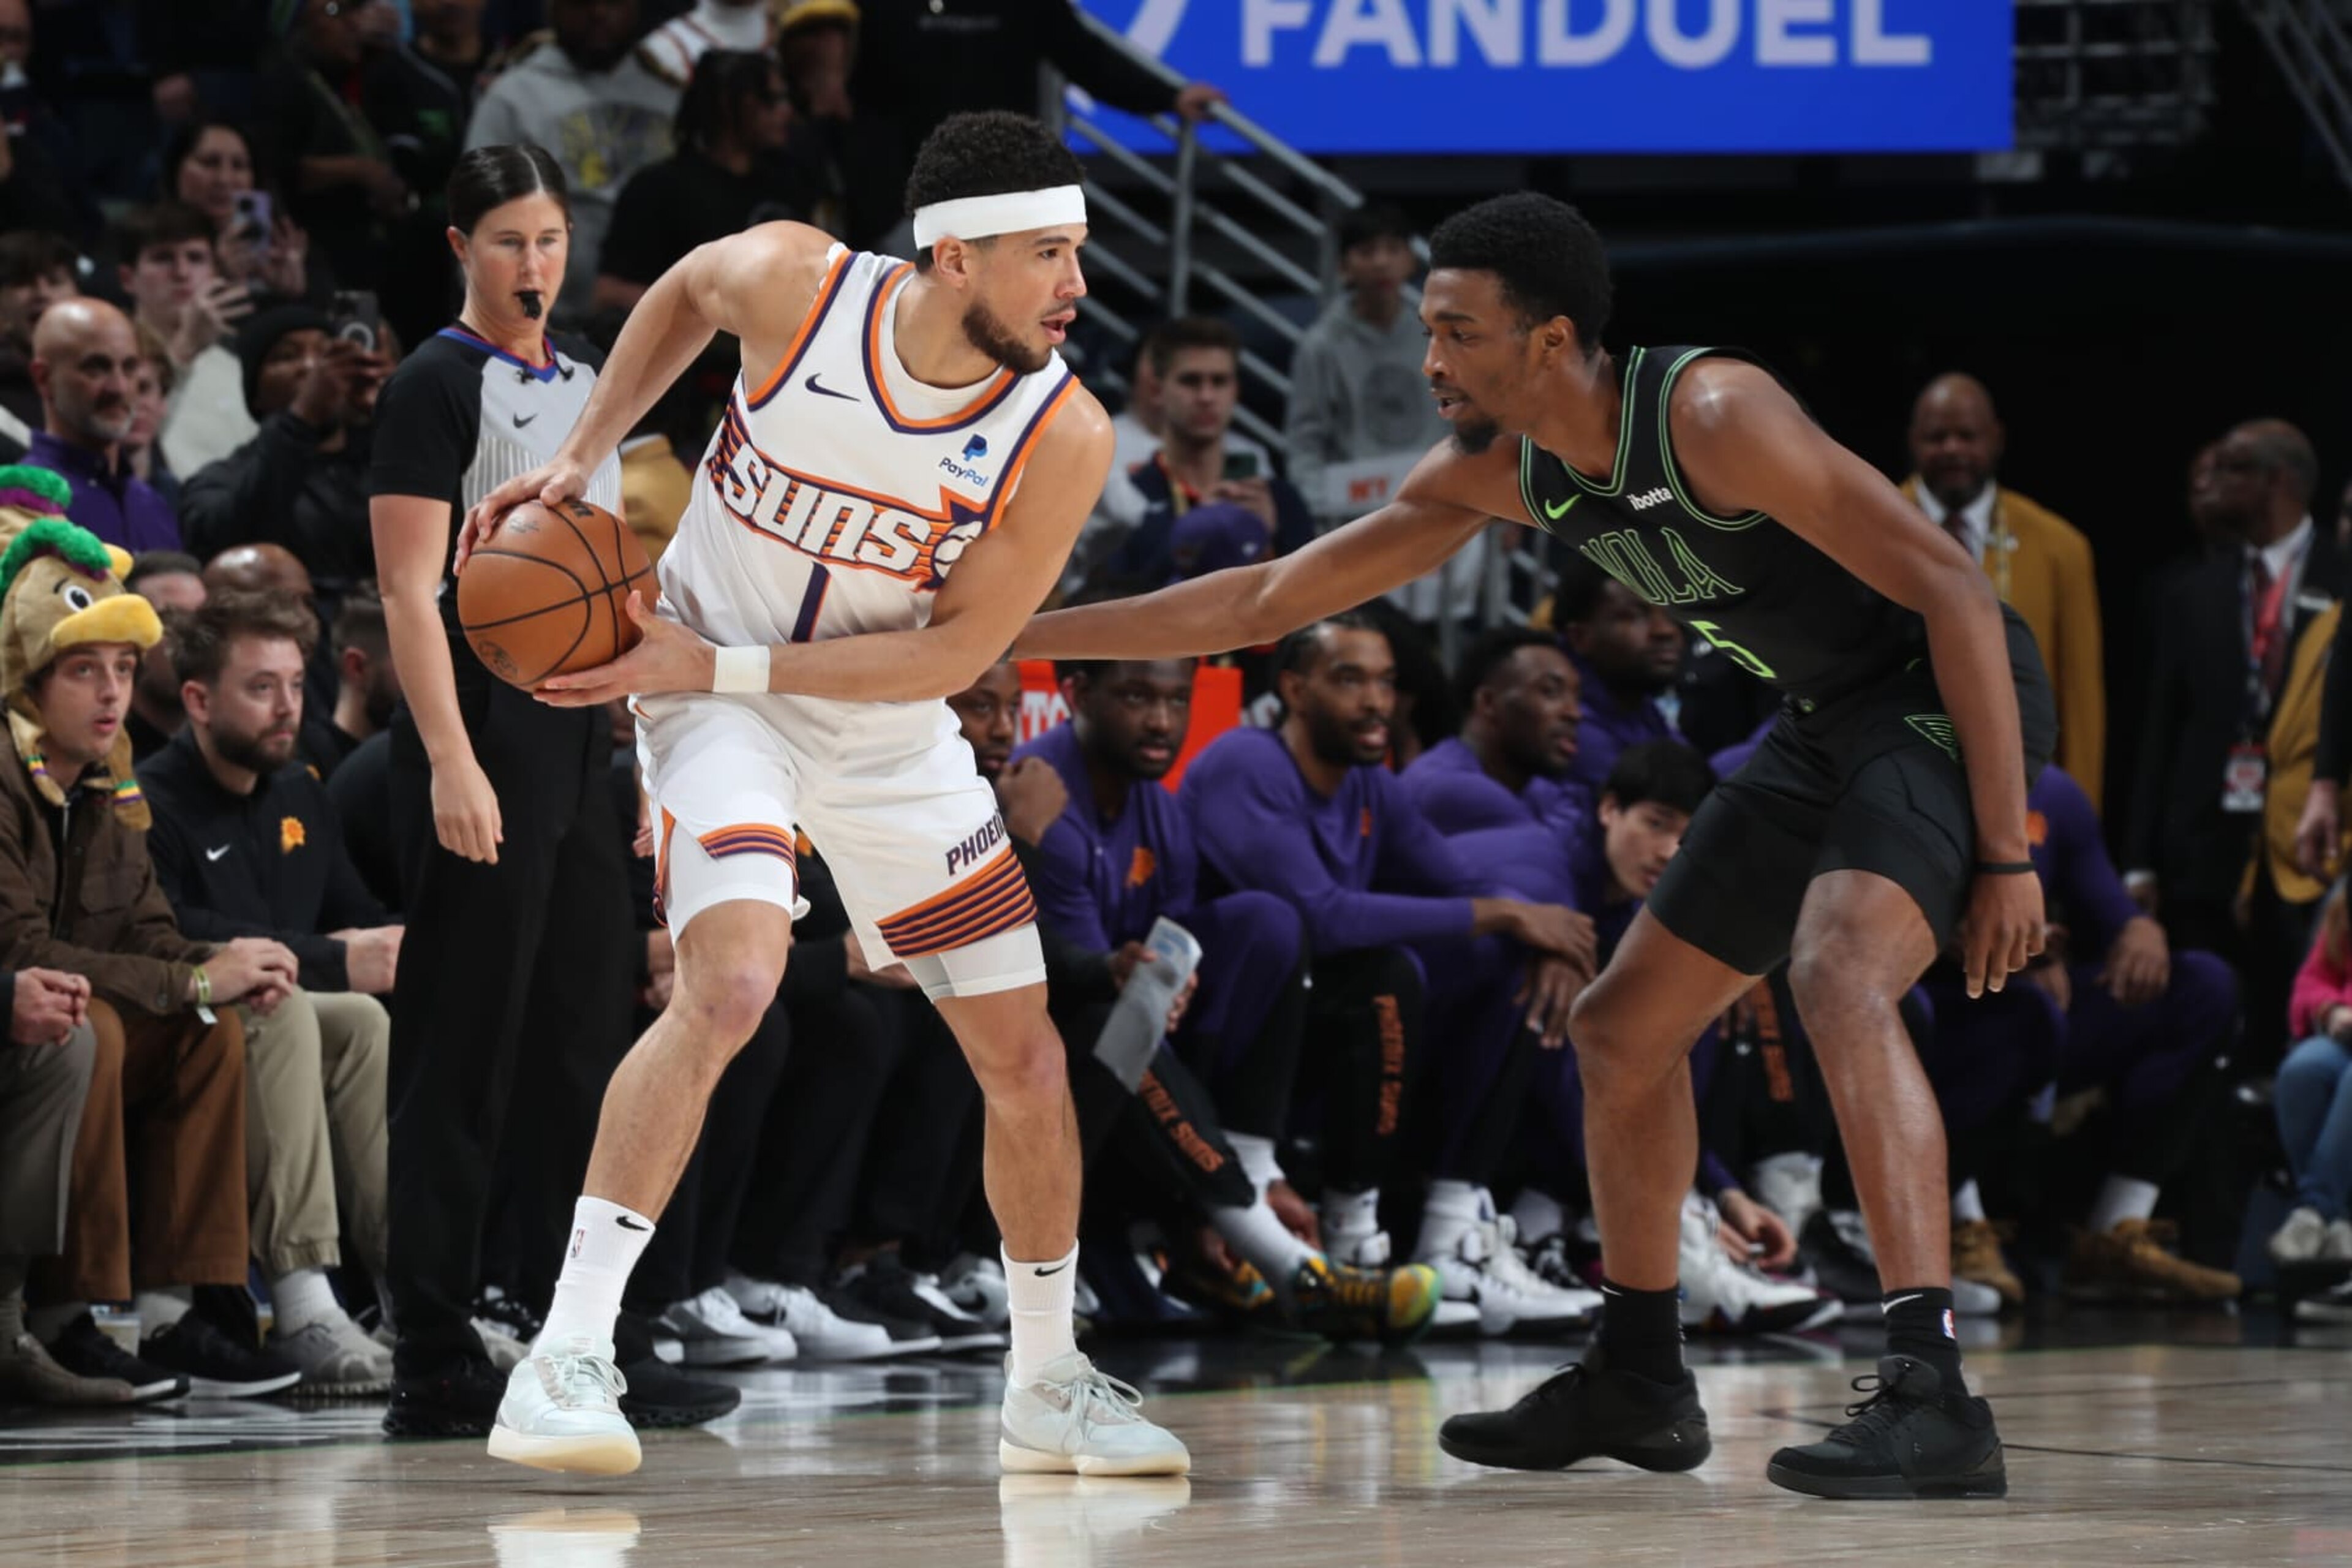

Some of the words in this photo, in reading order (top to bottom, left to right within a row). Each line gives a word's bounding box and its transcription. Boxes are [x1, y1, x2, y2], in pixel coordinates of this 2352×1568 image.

[1242, 0, 1932, 69] FANDUEL
[938, 456, 989, 487] PayPal
[722, 442, 932, 571] SUNS
[1626, 487, 1673, 511] ibotta
